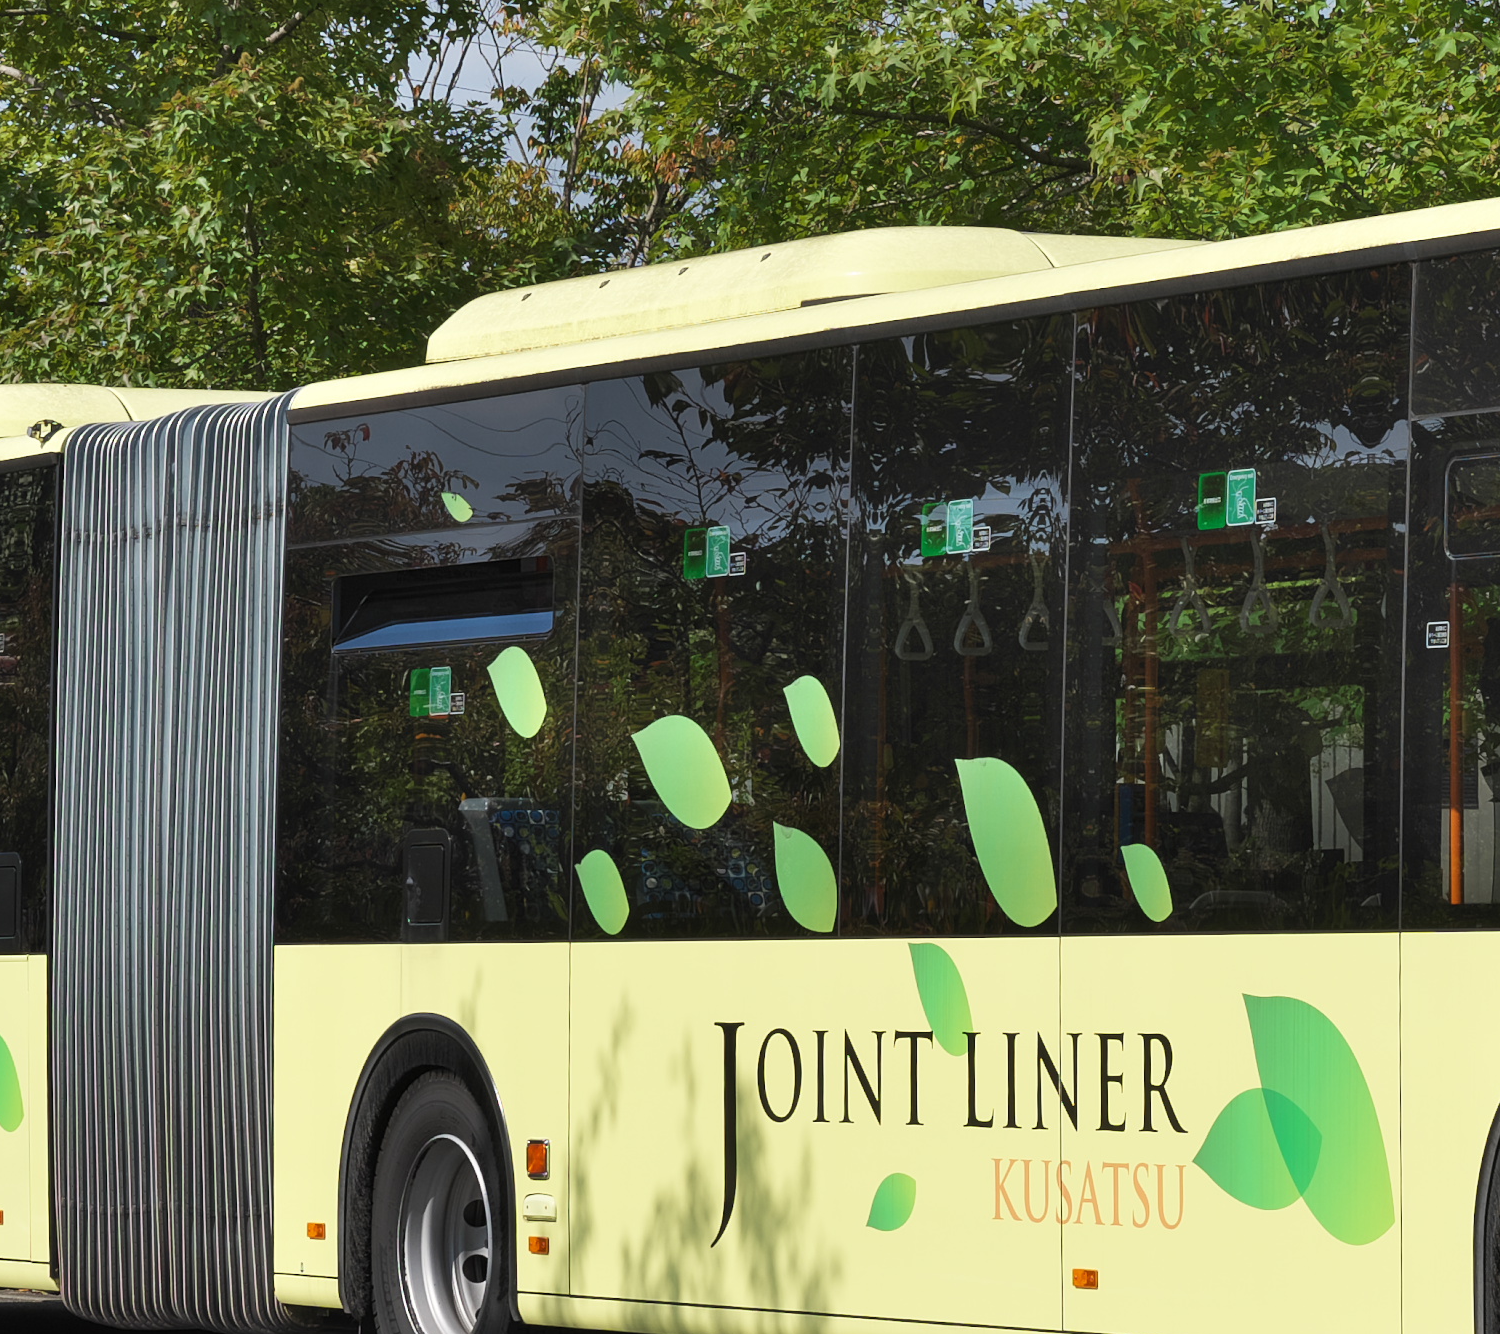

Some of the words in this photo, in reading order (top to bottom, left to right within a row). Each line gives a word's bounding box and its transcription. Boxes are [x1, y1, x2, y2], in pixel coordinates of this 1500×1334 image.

[710, 1021, 934, 1248] JOINT
[963, 1031, 1189, 1135] LINER
[991, 1157, 1187, 1230] KUSATSU
